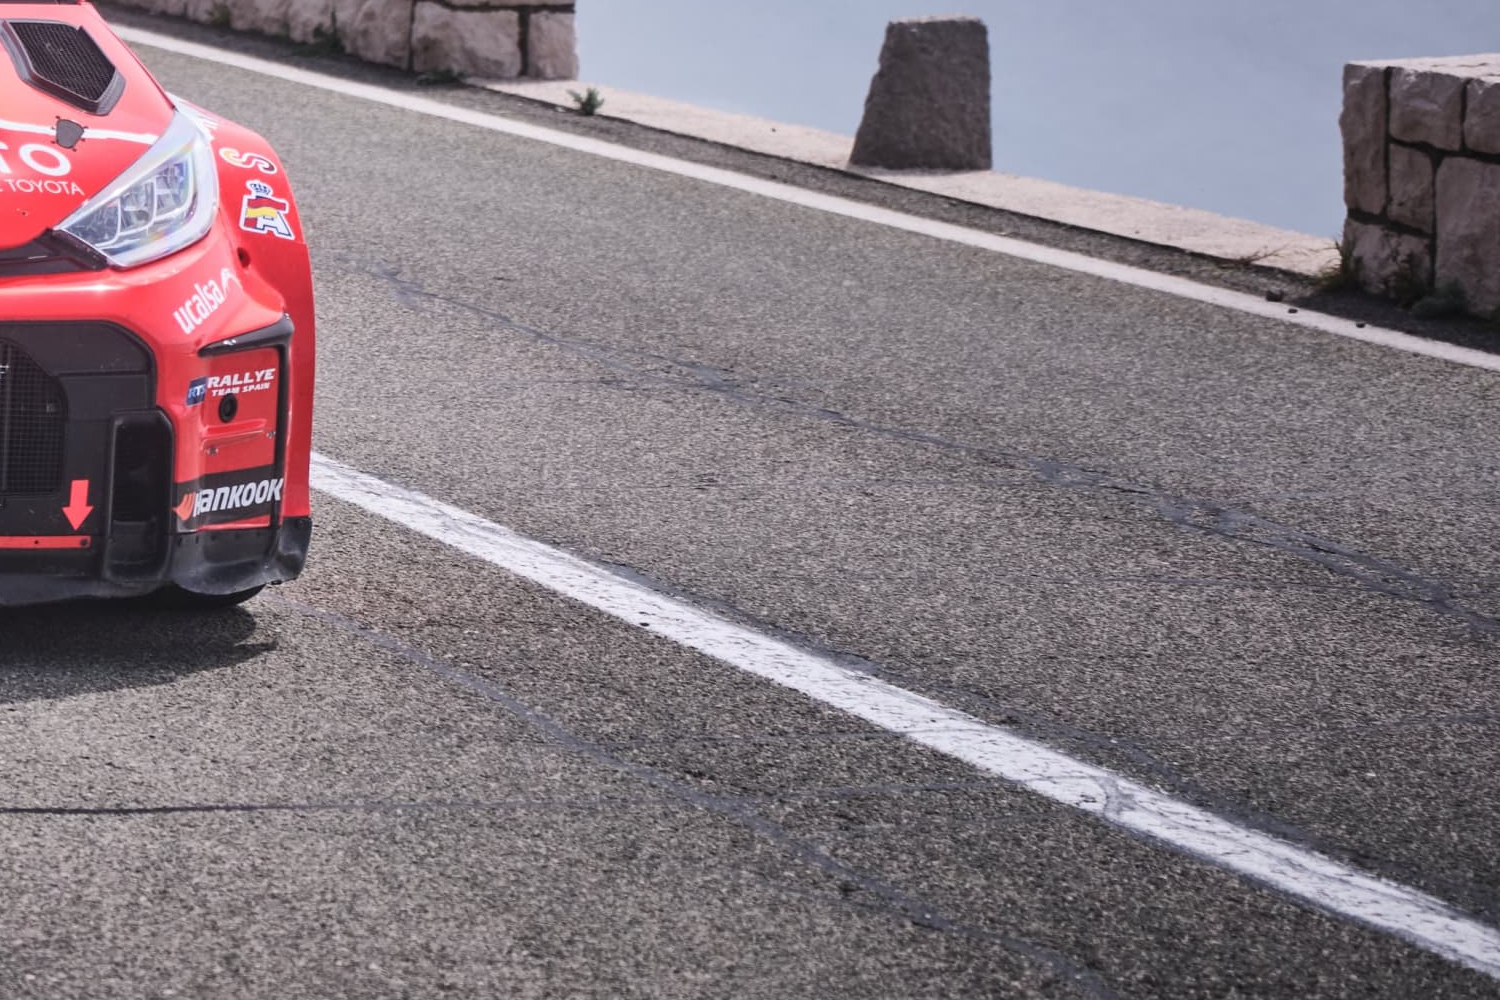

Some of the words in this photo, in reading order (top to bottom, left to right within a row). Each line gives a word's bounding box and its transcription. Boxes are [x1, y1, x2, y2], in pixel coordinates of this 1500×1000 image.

[4, 179, 85, 196] TOYOTA
[173, 280, 225, 335] ucalsa
[207, 368, 276, 389] RALLYE
[211, 387, 240, 397] TEAM
[242, 382, 271, 393] SPAIN
